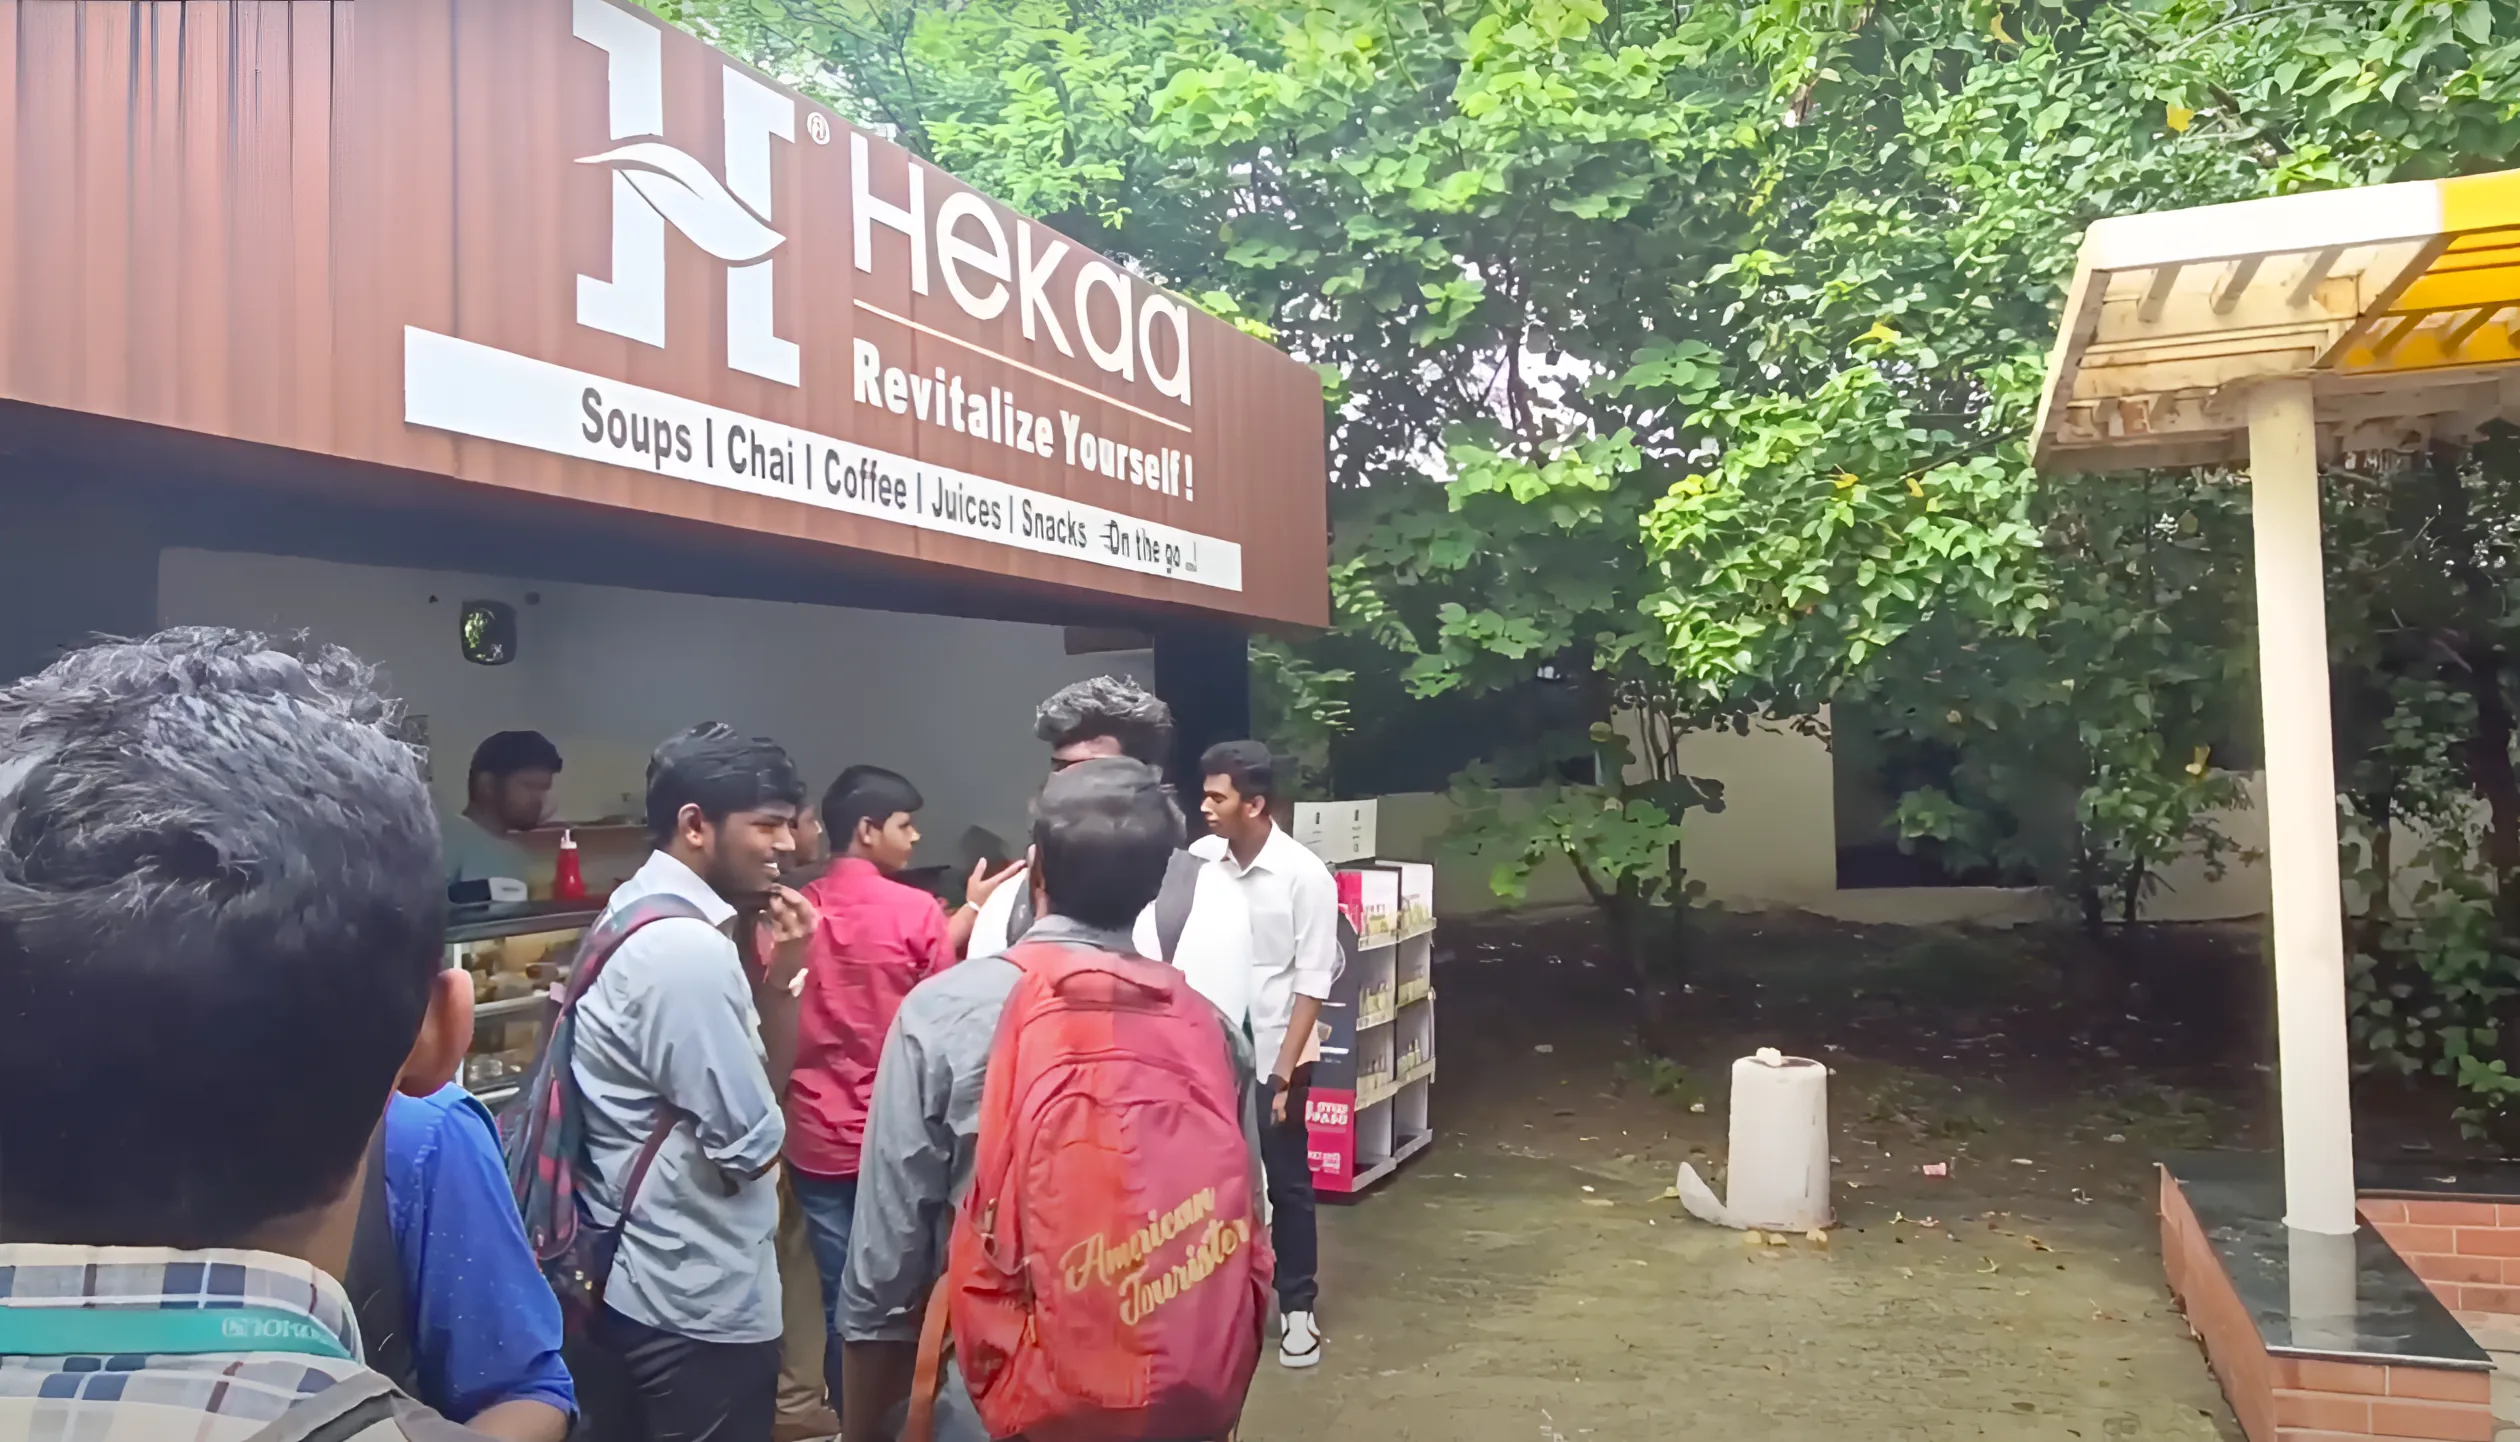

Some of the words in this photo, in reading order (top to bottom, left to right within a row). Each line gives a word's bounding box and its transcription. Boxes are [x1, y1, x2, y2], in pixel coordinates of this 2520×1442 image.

[850, 131, 1191, 406] Hekaa
[582, 387, 692, 470] Soups
[727, 424, 794, 485] Chai
[824, 448, 907, 510] Coffee
[931, 476, 1001, 530] Juices
[1022, 498, 1087, 549] Snacks
[1136, 527, 1160, 564] the
[853, 337, 1055, 458] Revitalize
